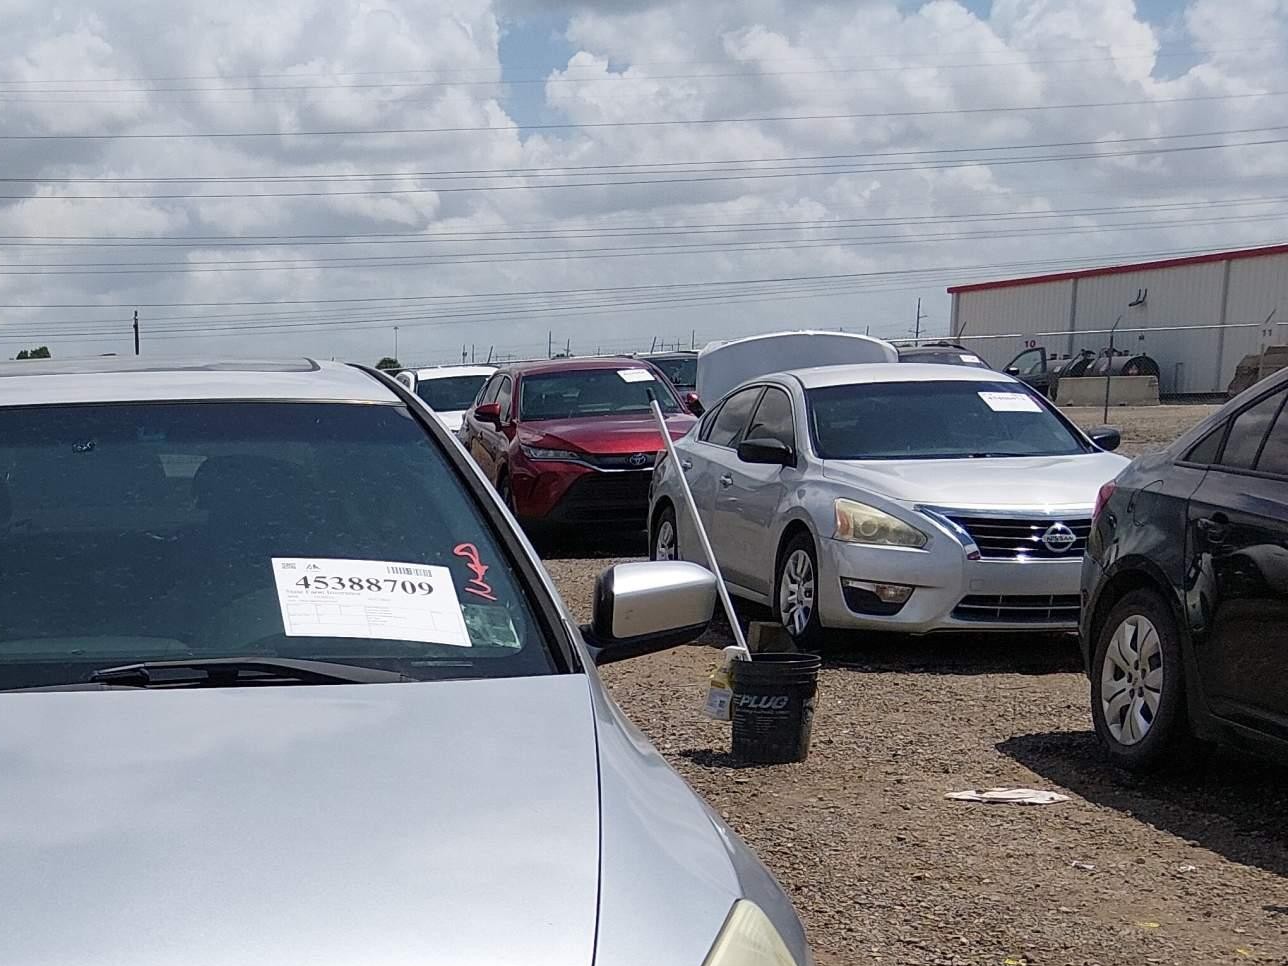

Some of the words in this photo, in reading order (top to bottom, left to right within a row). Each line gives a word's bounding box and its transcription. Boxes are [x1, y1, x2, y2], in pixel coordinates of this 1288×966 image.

[1024, 340, 1036, 348] 10
[1046, 534, 1073, 542] NISSAN
[295, 575, 434, 596] 45388709
